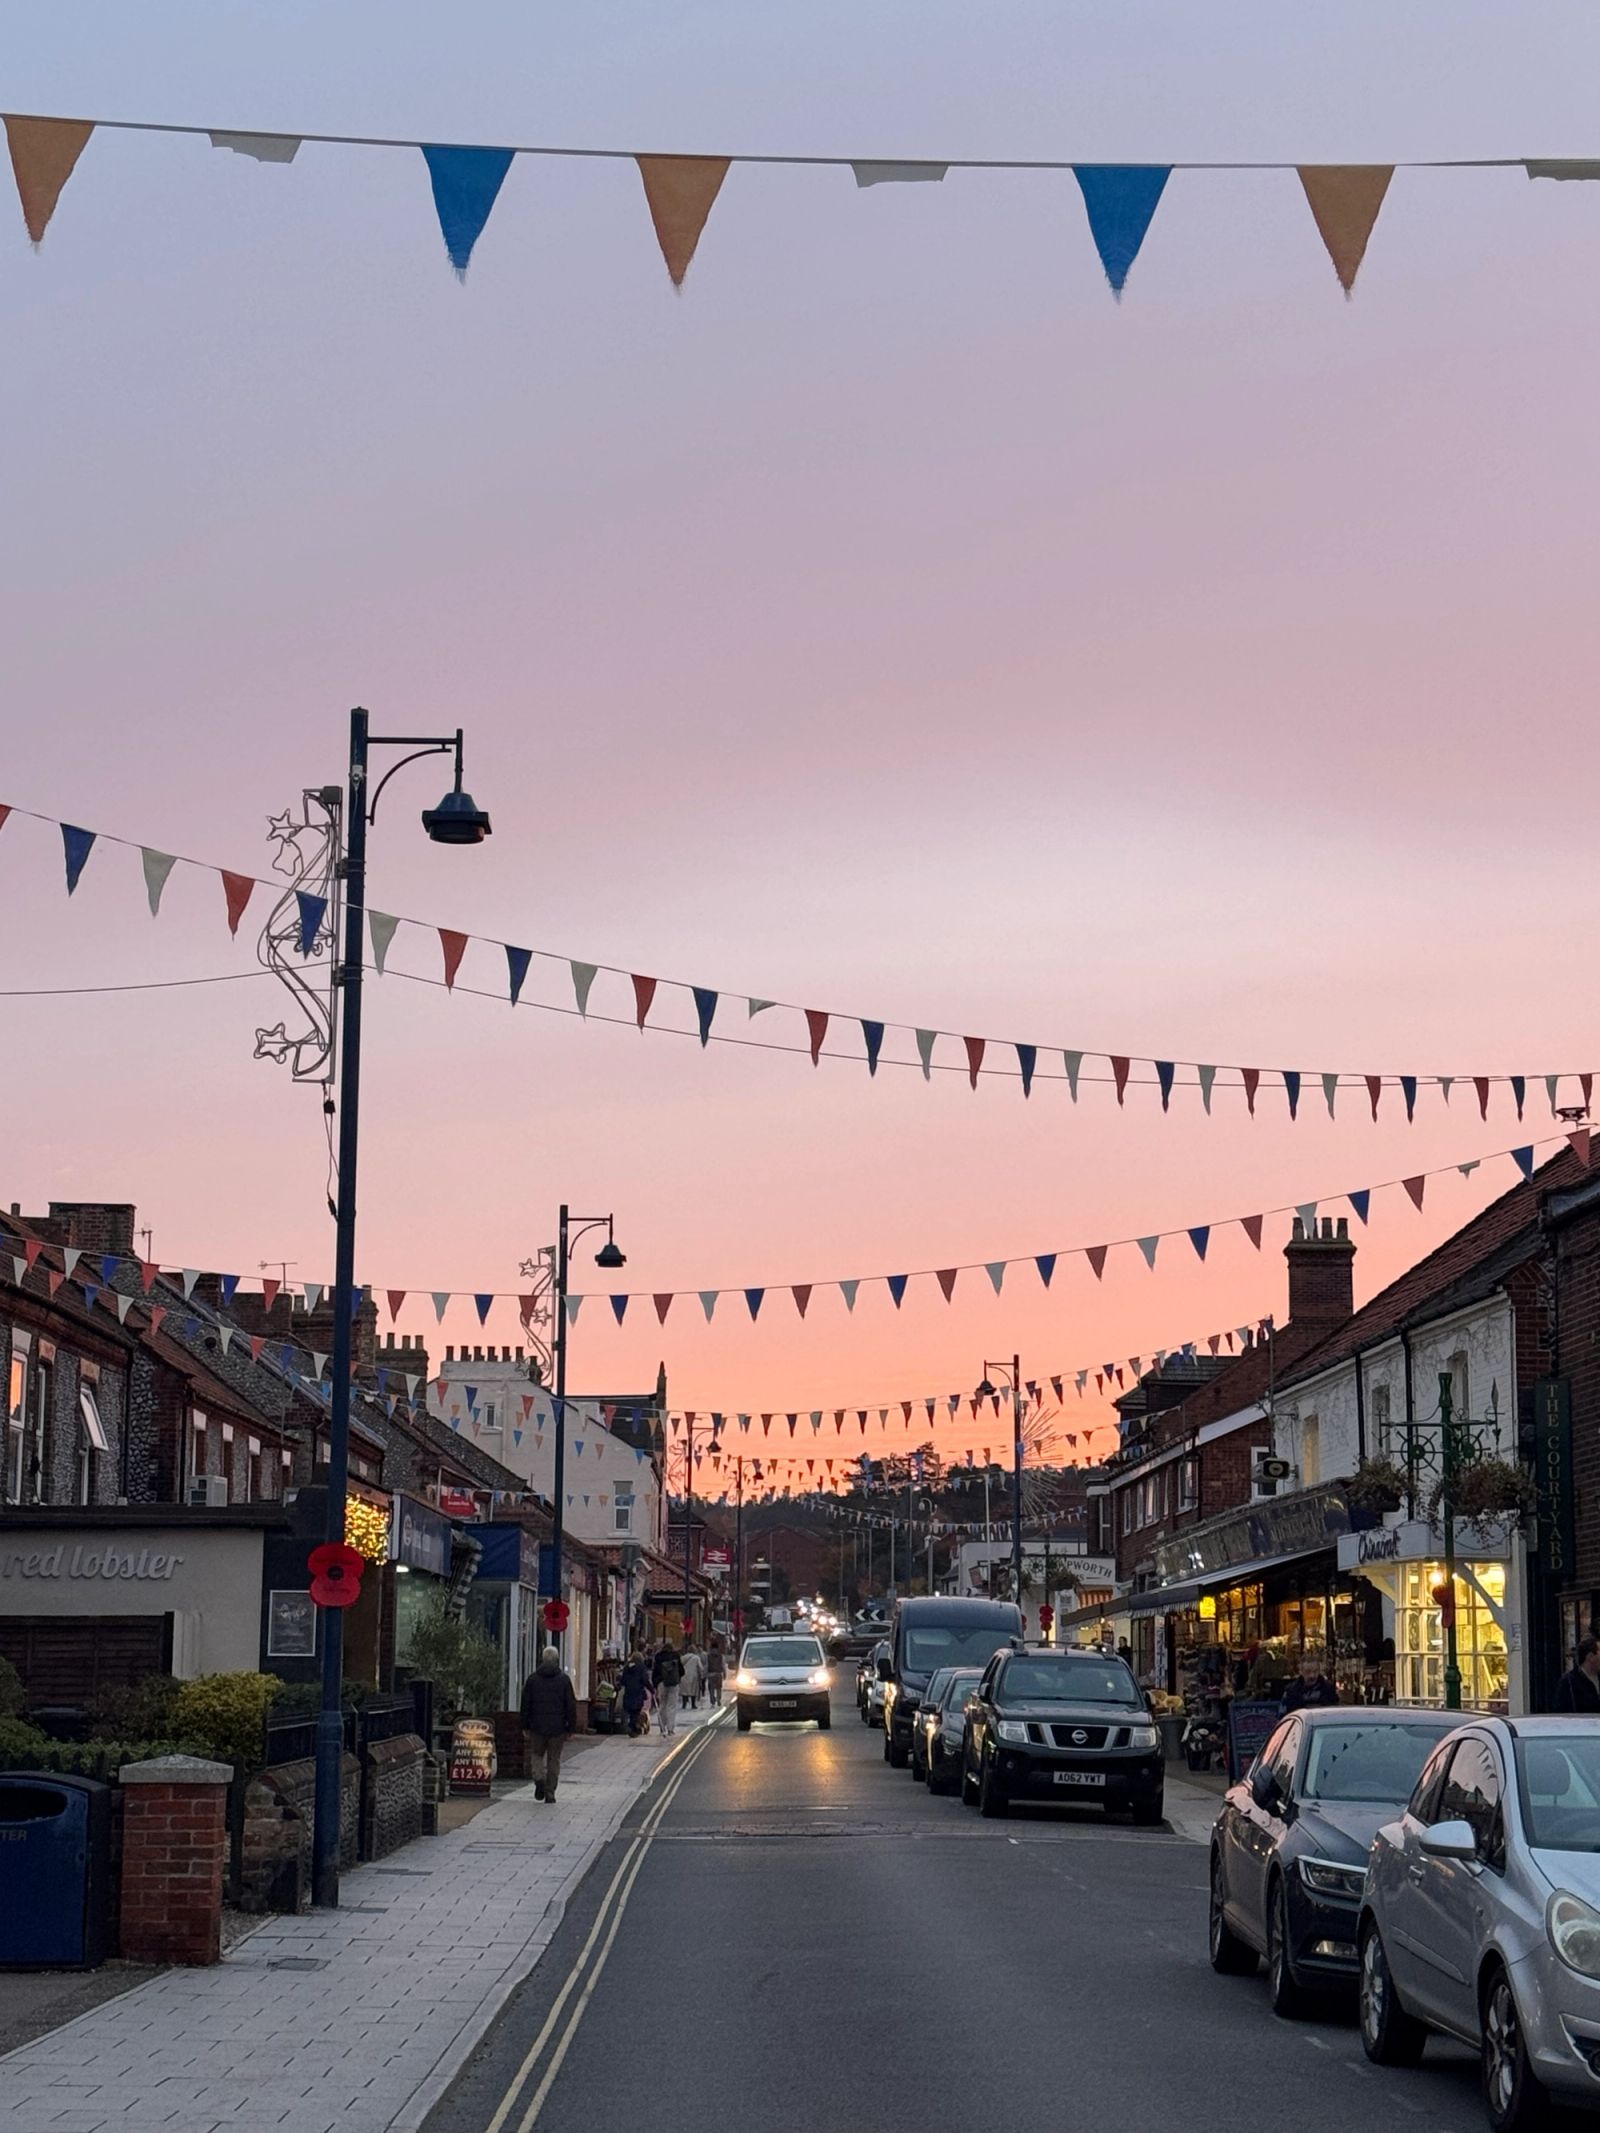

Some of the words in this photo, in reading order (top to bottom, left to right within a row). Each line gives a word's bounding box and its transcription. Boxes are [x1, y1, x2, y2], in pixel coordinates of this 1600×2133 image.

[1545, 1384, 1560, 1427] THE
[1547, 1436, 1564, 1570] COURTYARD
[2, 1545, 65, 1578] red
[69, 1545, 185, 1580] lobster
[470, 1740, 493, 1748] PIZZA
[456, 1749, 471, 1757] ANY
[472, 1749, 490, 1757] SIZE
[454, 1758, 470, 1766] ANY
[471, 1758, 489, 1767] TIME
[452, 1769, 490, 1779] £12.99
